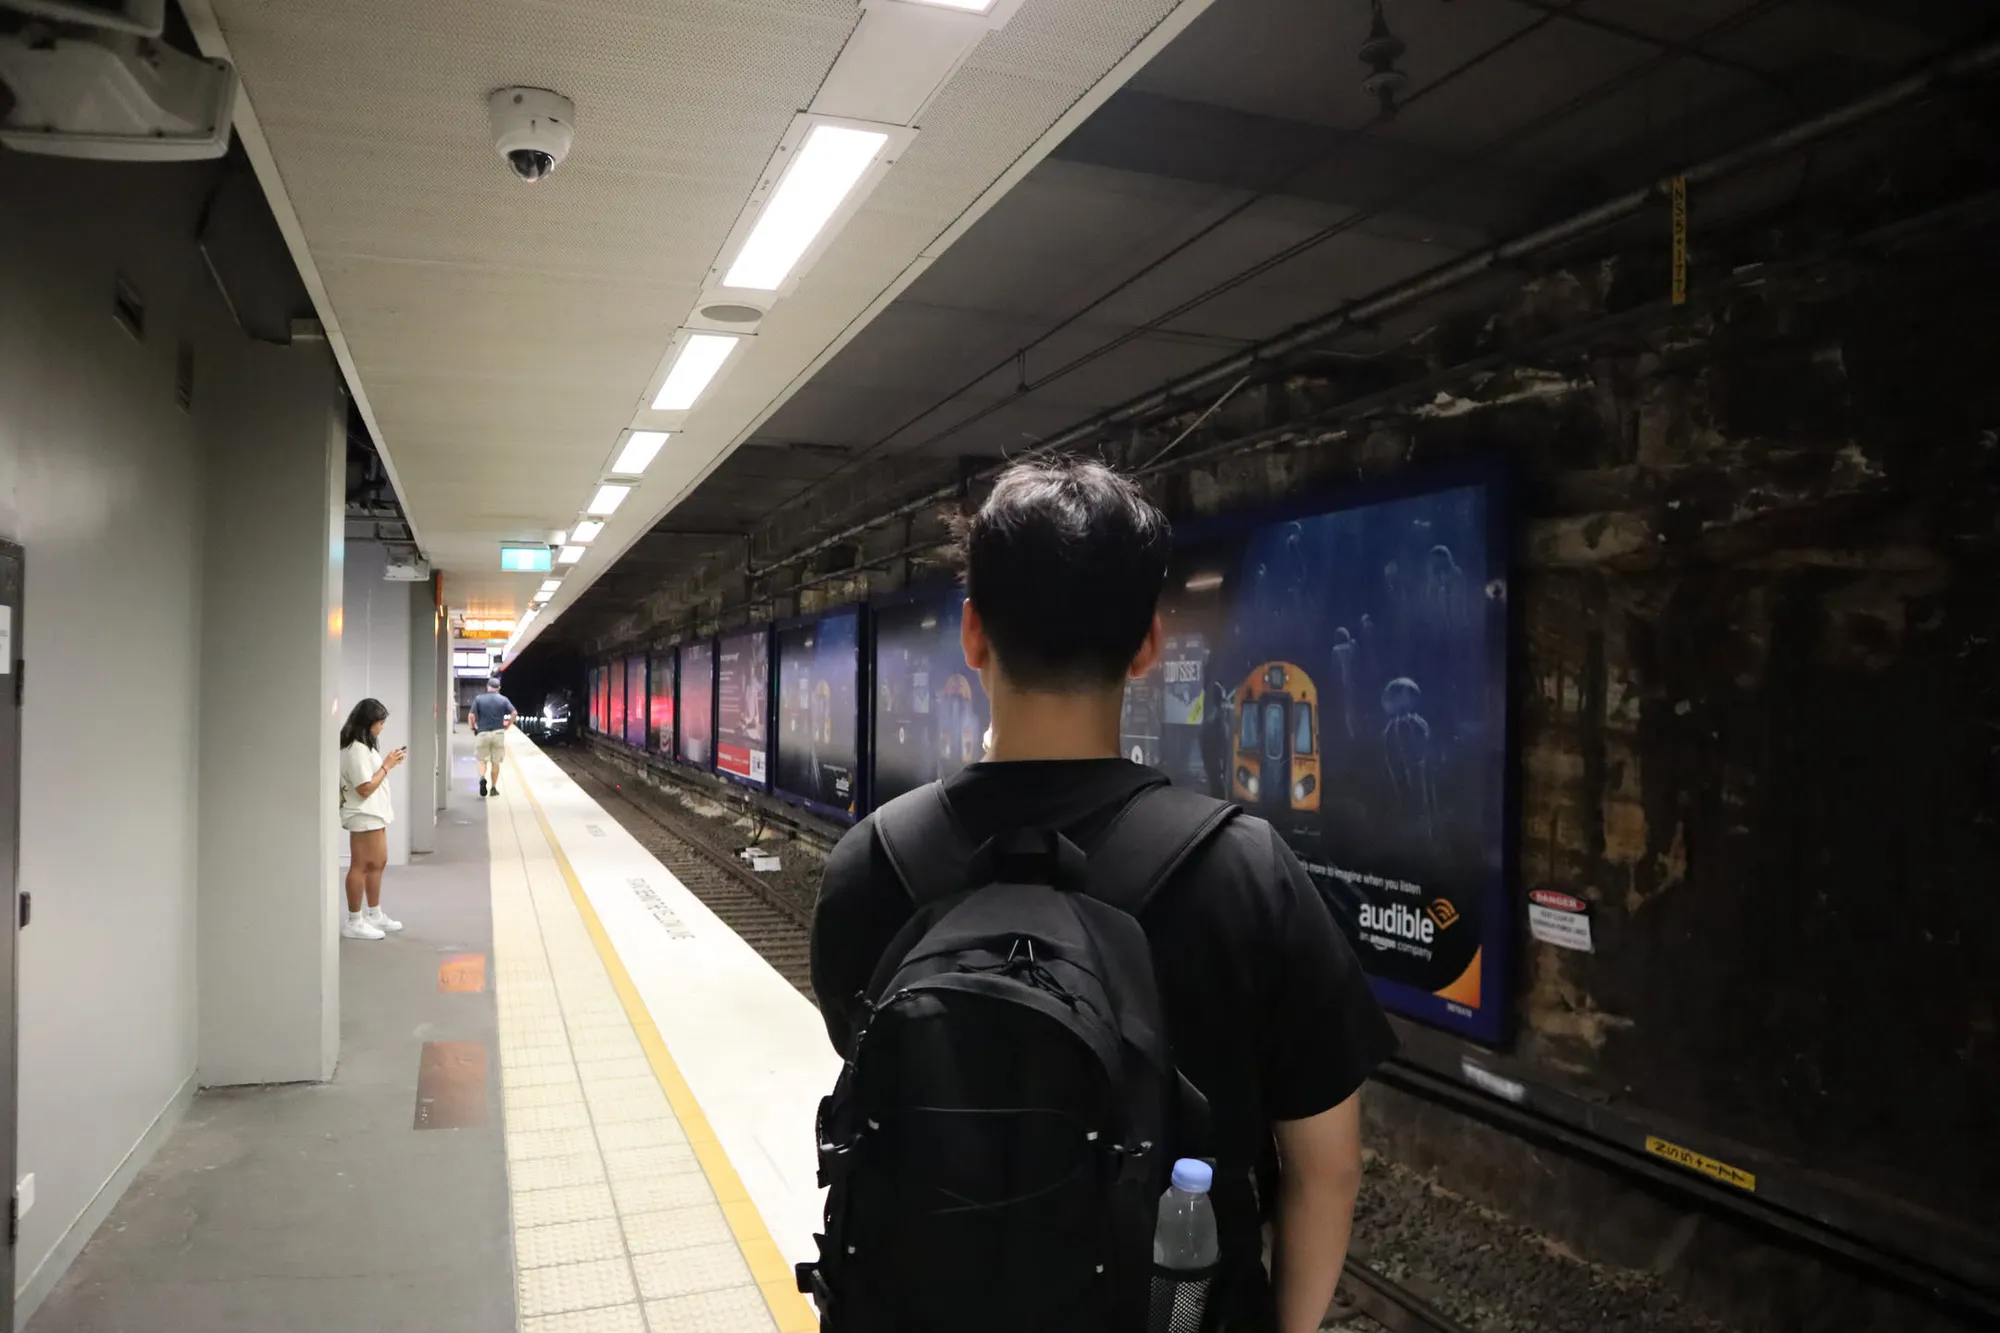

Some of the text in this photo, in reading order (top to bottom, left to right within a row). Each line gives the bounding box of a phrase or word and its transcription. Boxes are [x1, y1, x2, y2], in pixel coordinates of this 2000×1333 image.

[1335, 868, 1362, 884] imagine
[1363, 873, 1384, 888] when
[1385, 879, 1399, 891] you
[1400, 880, 1421, 895] listen
[1536, 892, 1578, 909] DANGER
[1359, 902, 1434, 944] audible
[1397, 941, 1432, 961] company
